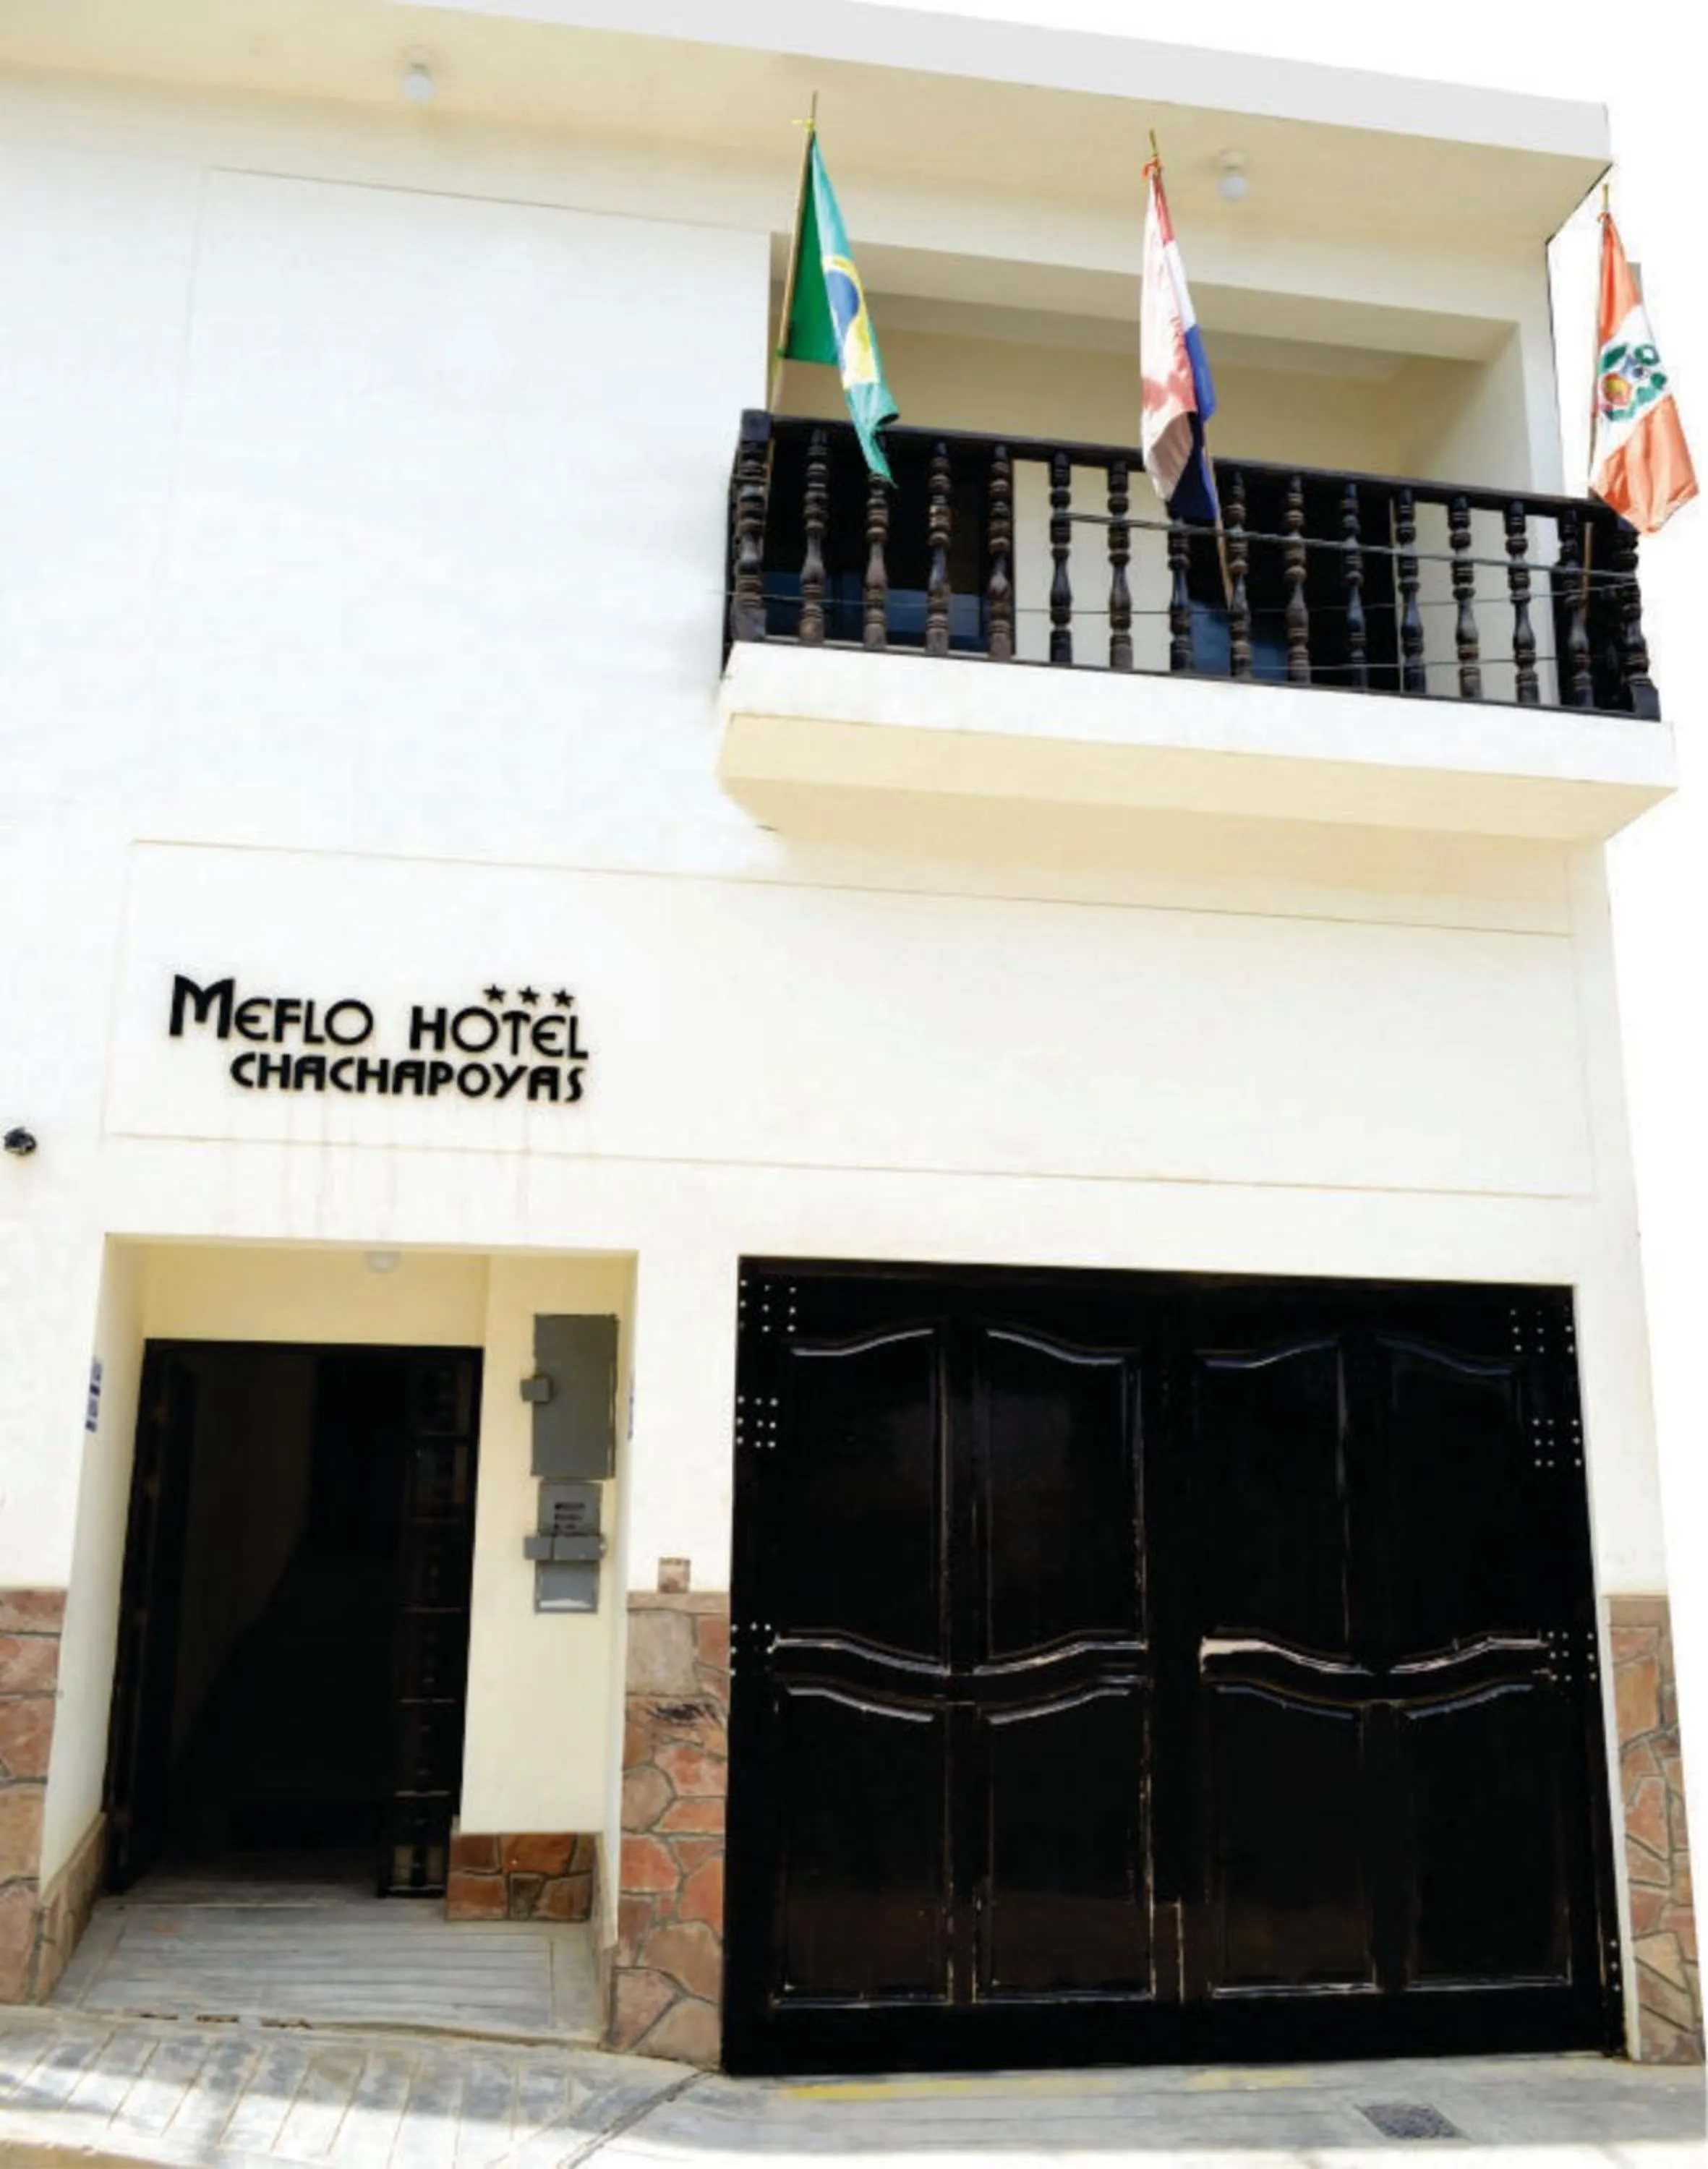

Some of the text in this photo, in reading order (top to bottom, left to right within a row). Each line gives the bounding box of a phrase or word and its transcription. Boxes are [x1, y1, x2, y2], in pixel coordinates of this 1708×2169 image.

[168, 974, 589, 1061] MEFLO HOTEL
[229, 1051, 584, 1103] CHACHAPOYAS
